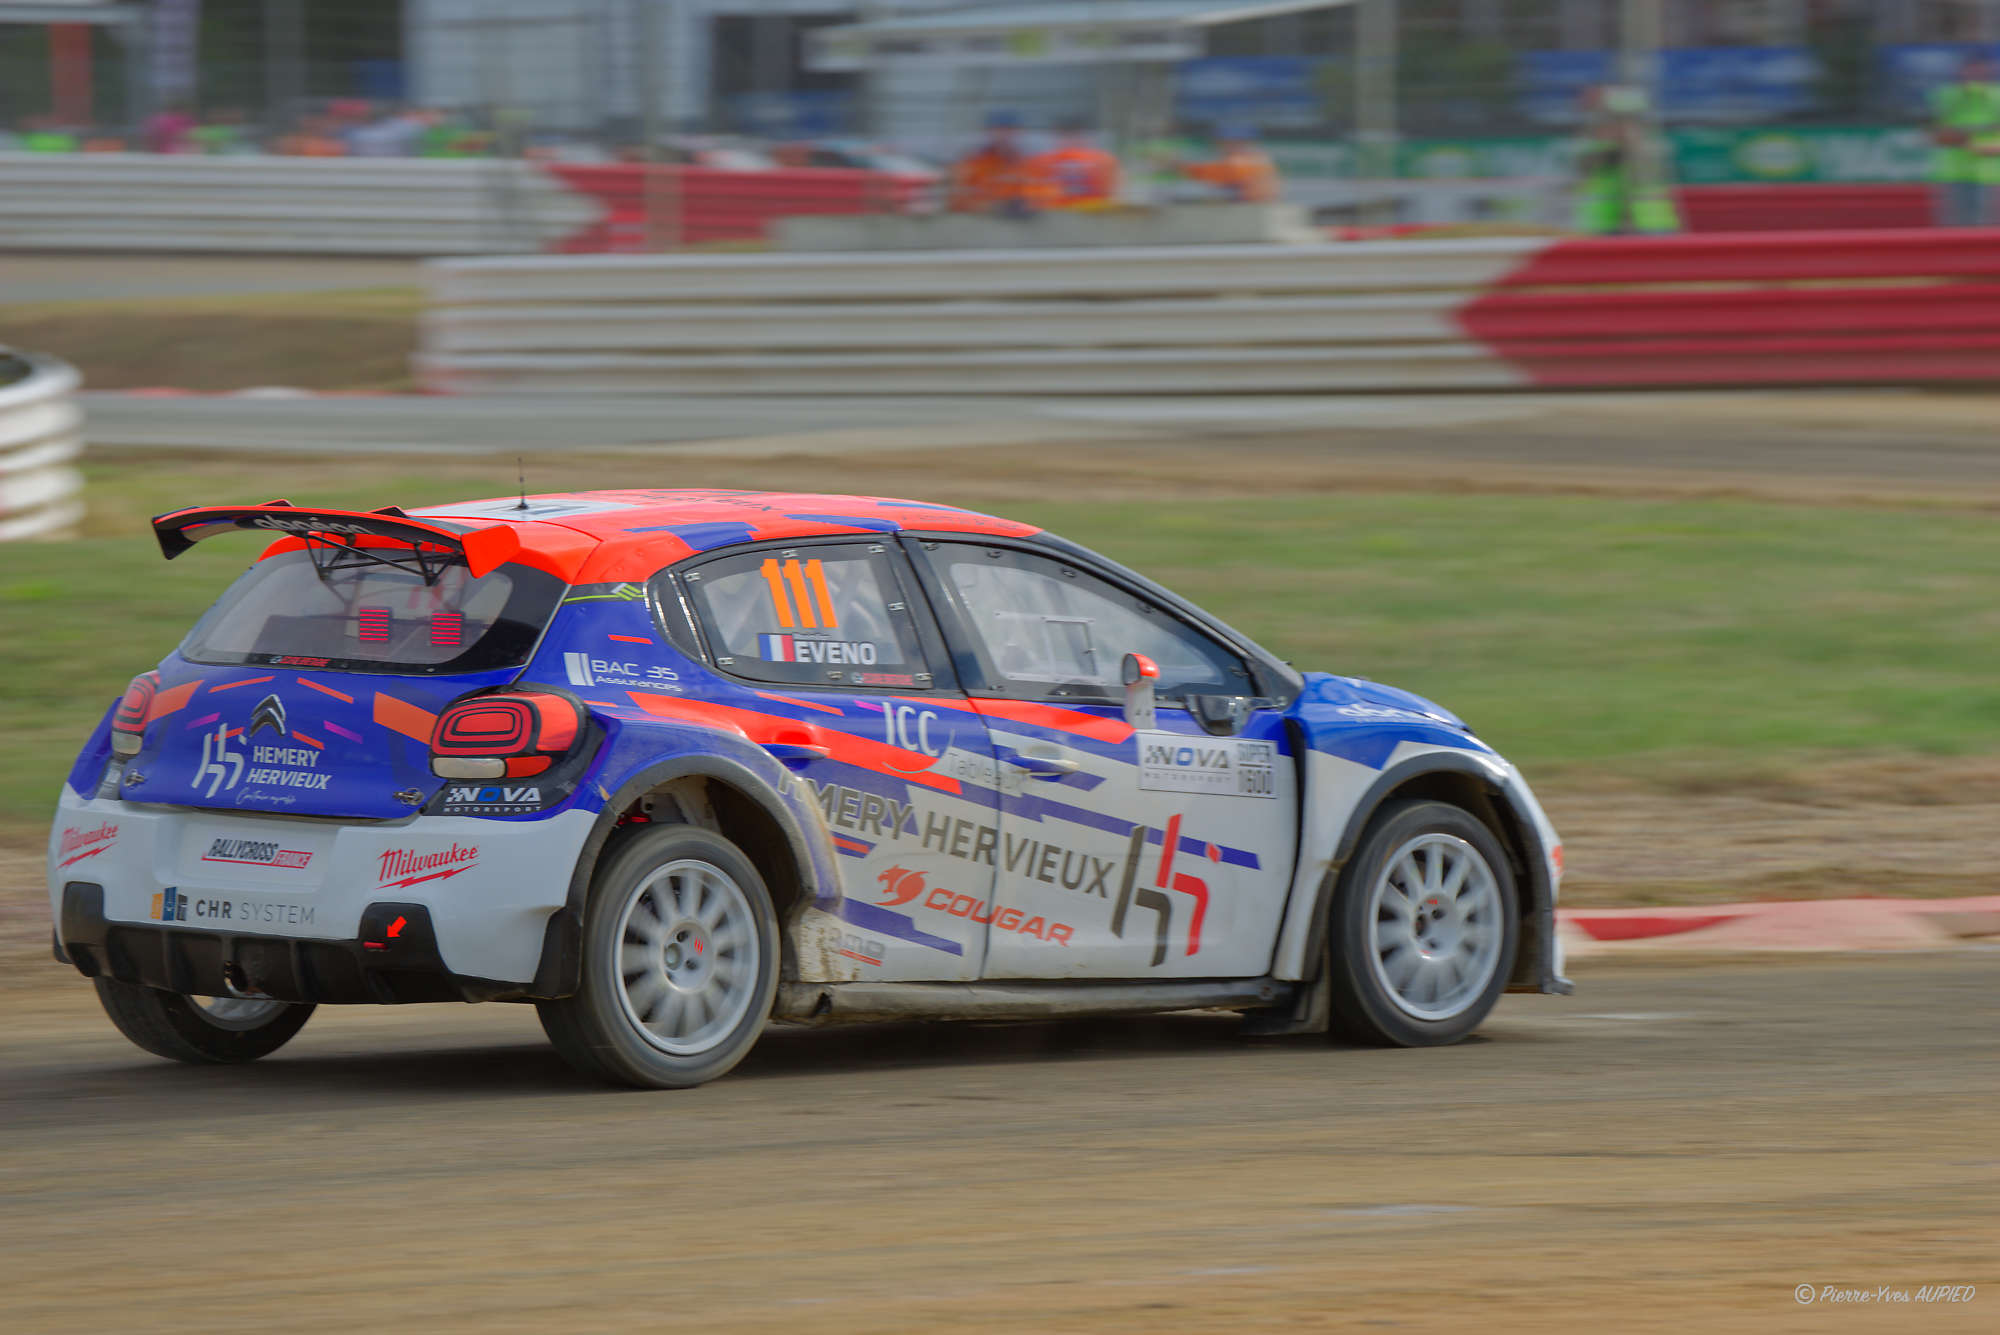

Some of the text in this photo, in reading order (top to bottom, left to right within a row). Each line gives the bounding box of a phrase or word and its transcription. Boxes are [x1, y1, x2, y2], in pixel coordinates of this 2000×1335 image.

[760, 558, 839, 628] 111
[794, 640, 877, 665] EVENO
[591, 659, 680, 681] BAC 35
[595, 675, 683, 692] Assurances
[882, 701, 938, 757] ICC
[252, 745, 320, 768] HEMERY
[1143, 744, 1229, 768] NOVA
[246, 767, 333, 790] HERVIEUX
[446, 787, 541, 802] NOVA
[207, 838, 280, 861] RALLYCROSS
[377, 842, 480, 881] Milwaukee
[921, 810, 1116, 899] HERVIEUX
[196, 899, 316, 925] CHR SYSTEM
[924, 887, 1075, 947] COUGAR
